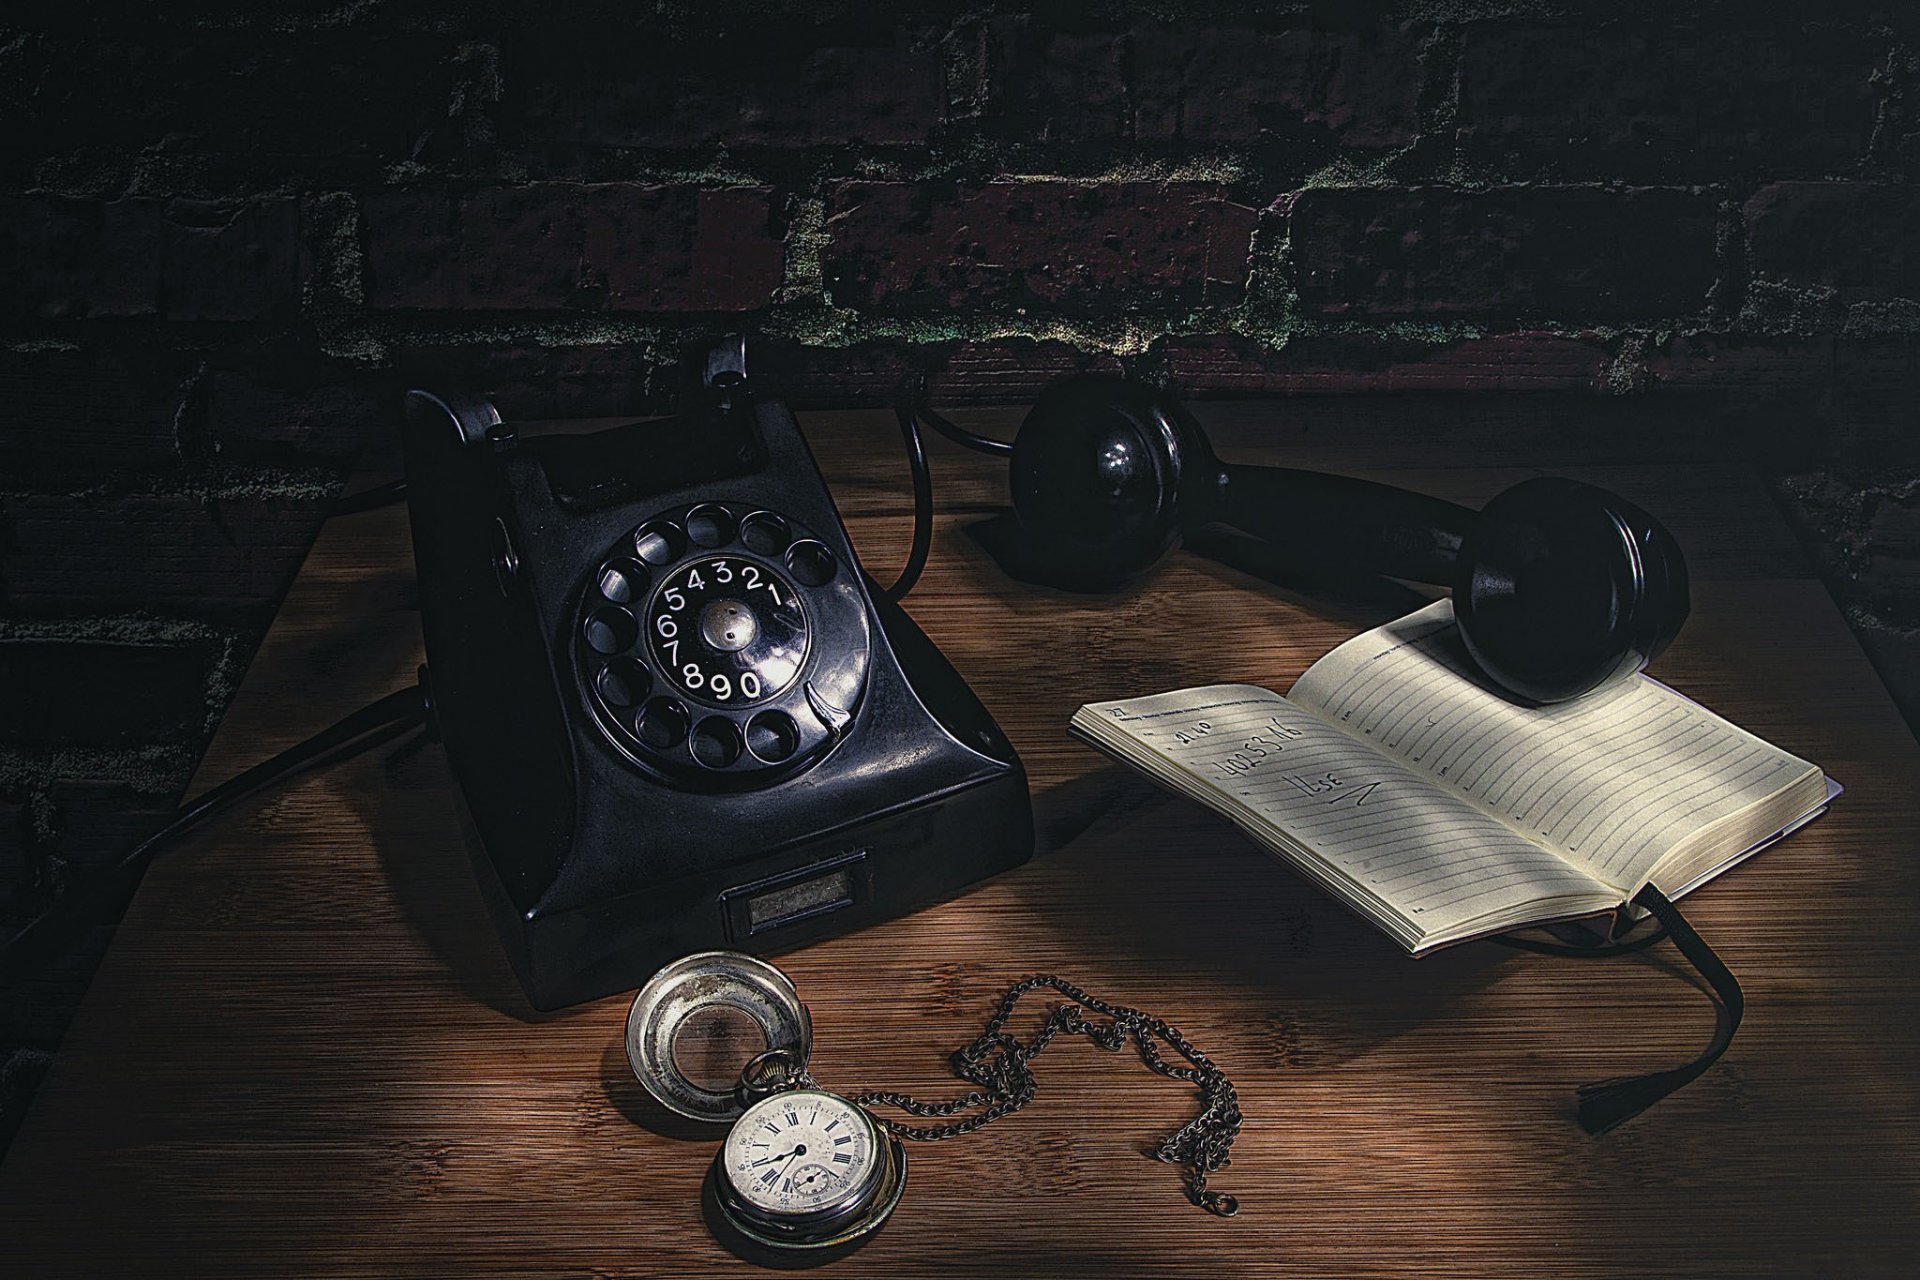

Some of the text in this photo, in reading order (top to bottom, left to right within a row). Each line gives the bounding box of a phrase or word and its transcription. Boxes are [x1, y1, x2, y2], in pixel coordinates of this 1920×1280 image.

[687, 569, 706, 590] 4
[711, 561, 733, 583] 3
[741, 566, 764, 590] 2
[664, 587, 685, 611] 5
[768, 583, 782, 606] 1
[657, 614, 678, 638] 6
[662, 640, 679, 667] 7
[682, 663, 704, 688] 8
[710, 673, 732, 700] 9
[740, 671, 761, 699] 0
[1105, 707, 1127, 717] 27
[824, 1119, 839, 1132] II
[834, 1135, 853, 1147] III
